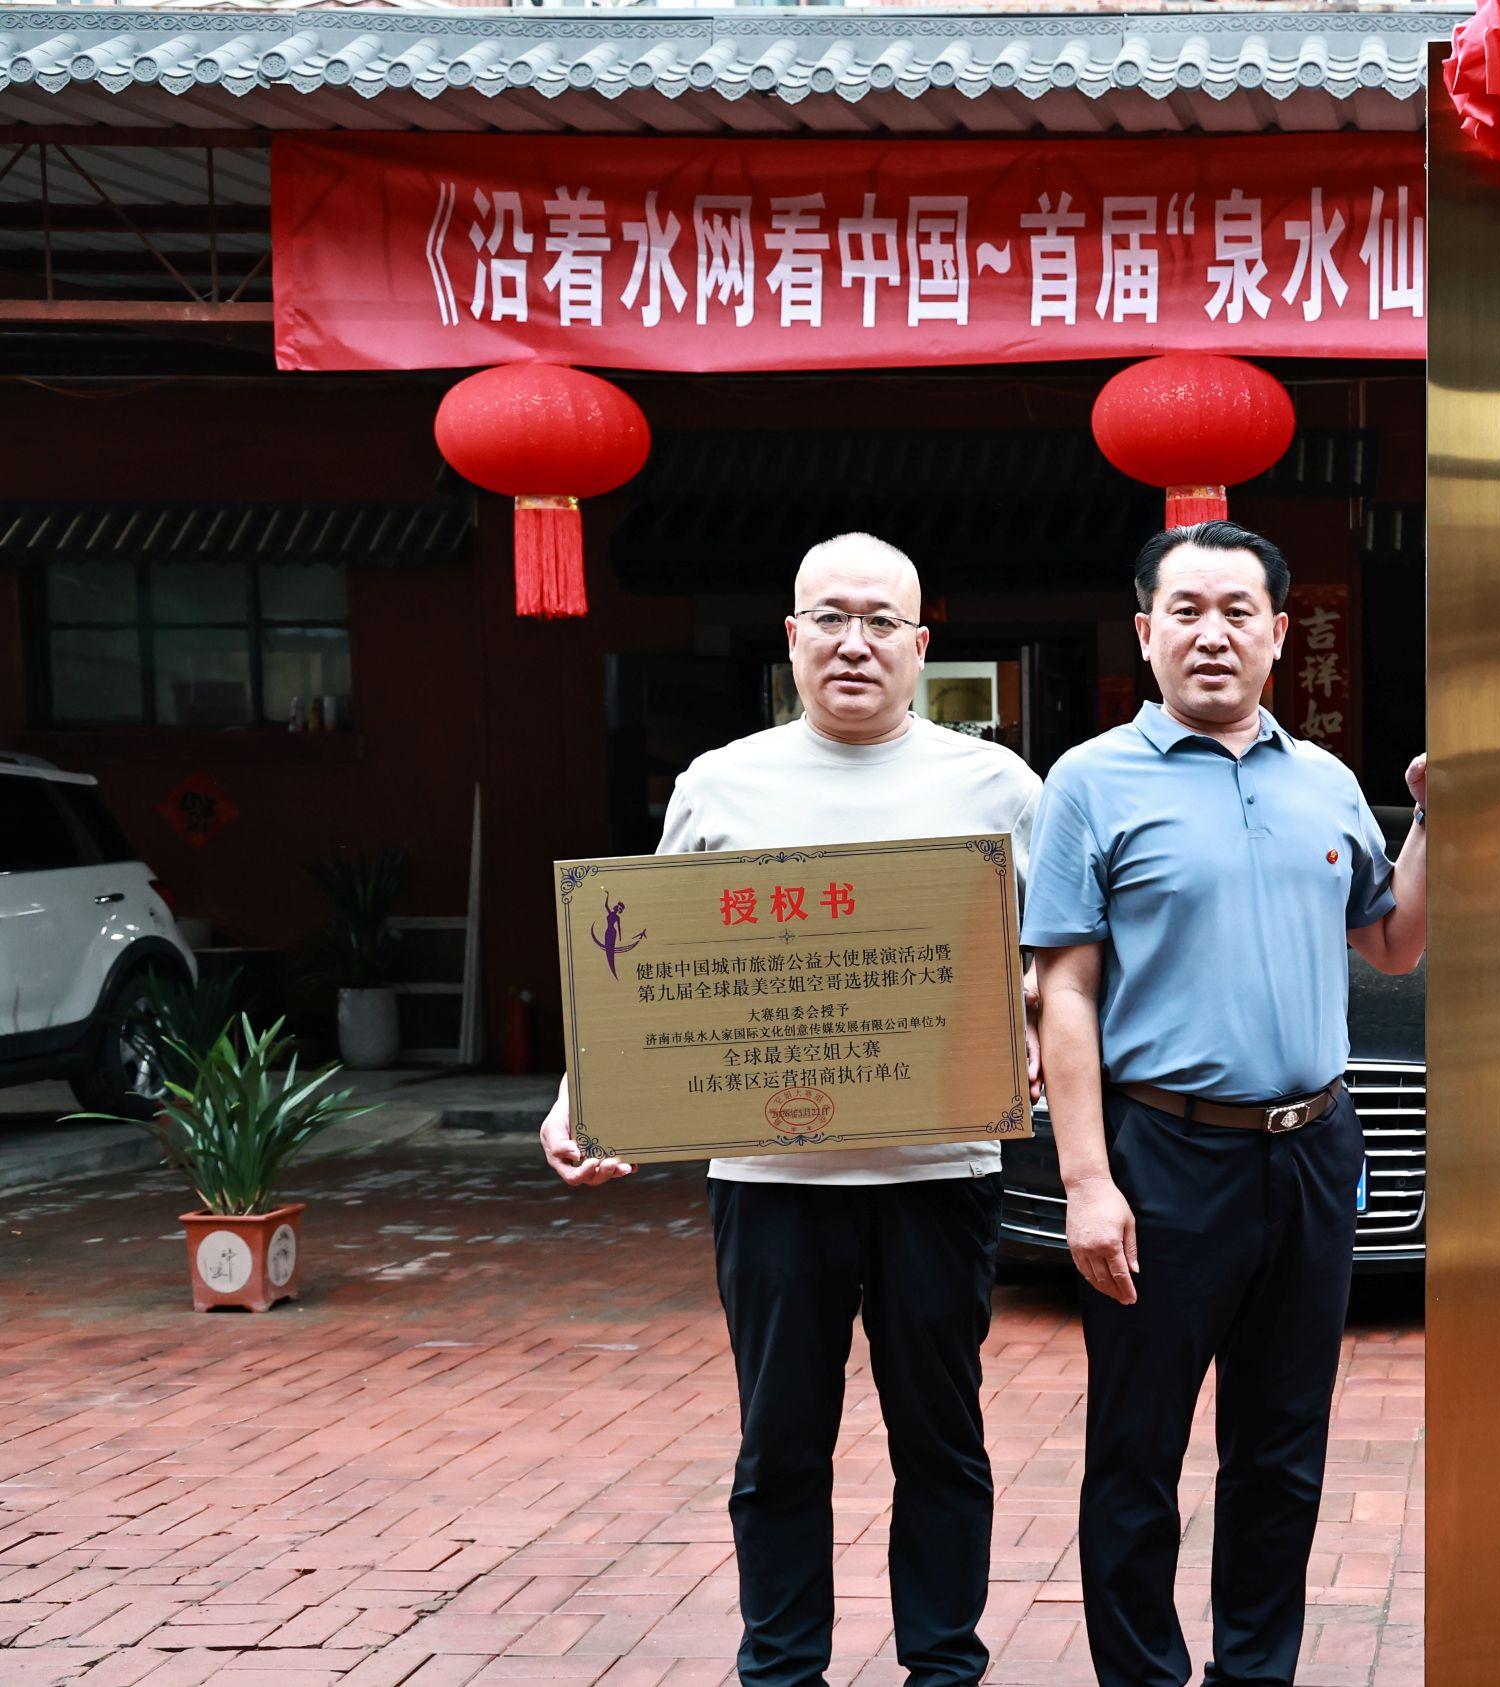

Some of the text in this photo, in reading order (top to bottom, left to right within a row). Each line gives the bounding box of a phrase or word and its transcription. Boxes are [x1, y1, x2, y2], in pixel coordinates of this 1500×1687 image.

[1299, 606, 1343, 758] 吉祥如
[720, 882, 858, 925] 授权书
[636, 943, 952, 981] 健康中国城市旅游公益大使展演活动暨
[638, 966, 954, 1003] 第九届全球最美空姐空哥选拔推介大赛
[748, 1003, 849, 1023] 大赛组委会授予
[645, 1015, 946, 1046] 济南市泉水人家国际文化创意传媒发展有限公司单位为
[722, 1040, 882, 1067] 全球最美空姐大赛
[688, 1062, 912, 1093] 山东赛区运营招商执行单位
